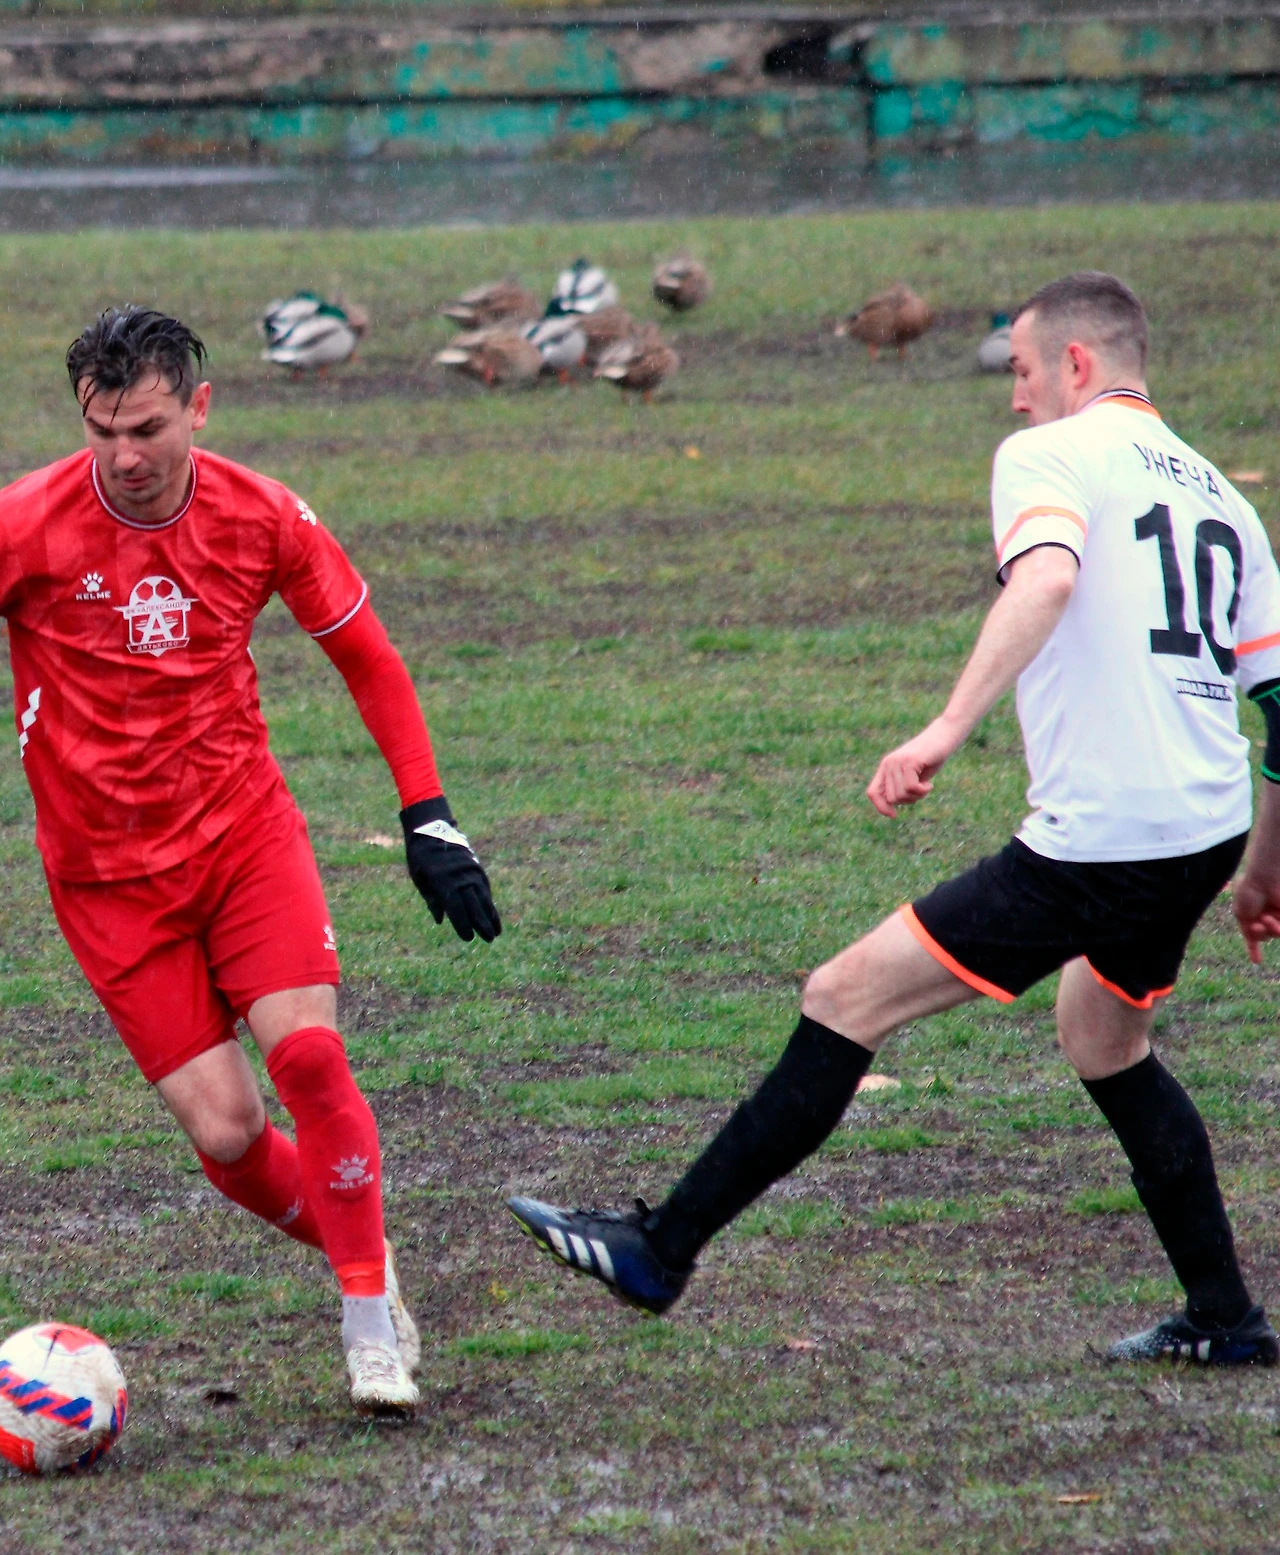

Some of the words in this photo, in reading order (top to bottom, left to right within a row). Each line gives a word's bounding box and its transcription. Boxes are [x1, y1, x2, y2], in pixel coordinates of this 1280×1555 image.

[1132, 442, 1224, 502] УНЕЧА
[75, 591, 111, 600] KELME
[1135, 502, 1242, 676] 10
